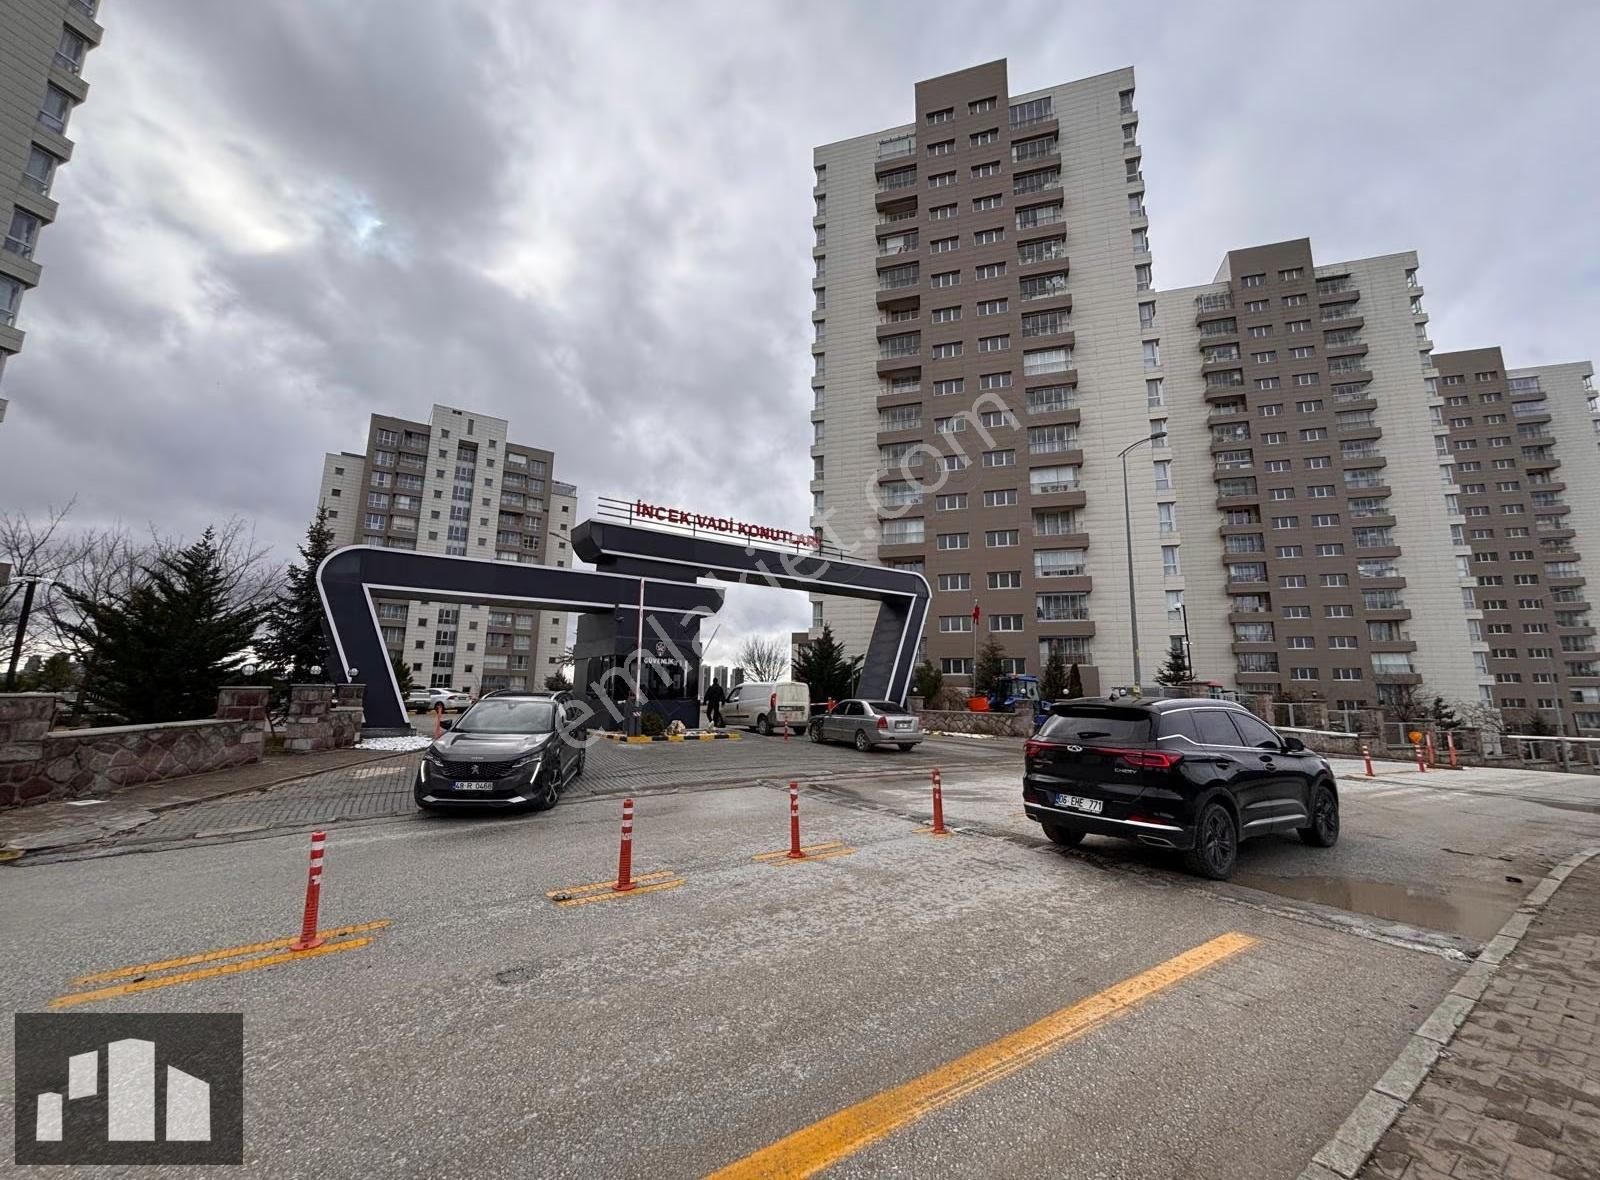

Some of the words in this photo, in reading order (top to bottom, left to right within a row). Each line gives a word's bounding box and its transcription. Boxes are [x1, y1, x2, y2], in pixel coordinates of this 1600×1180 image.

[636, 499, 691, 526] İNCEK
[696, 514, 735, 534] VADİ
[1059, 794, 1068, 804] 06
[1070, 796, 1084, 808] EHE
[1089, 799, 1102, 811] 771
